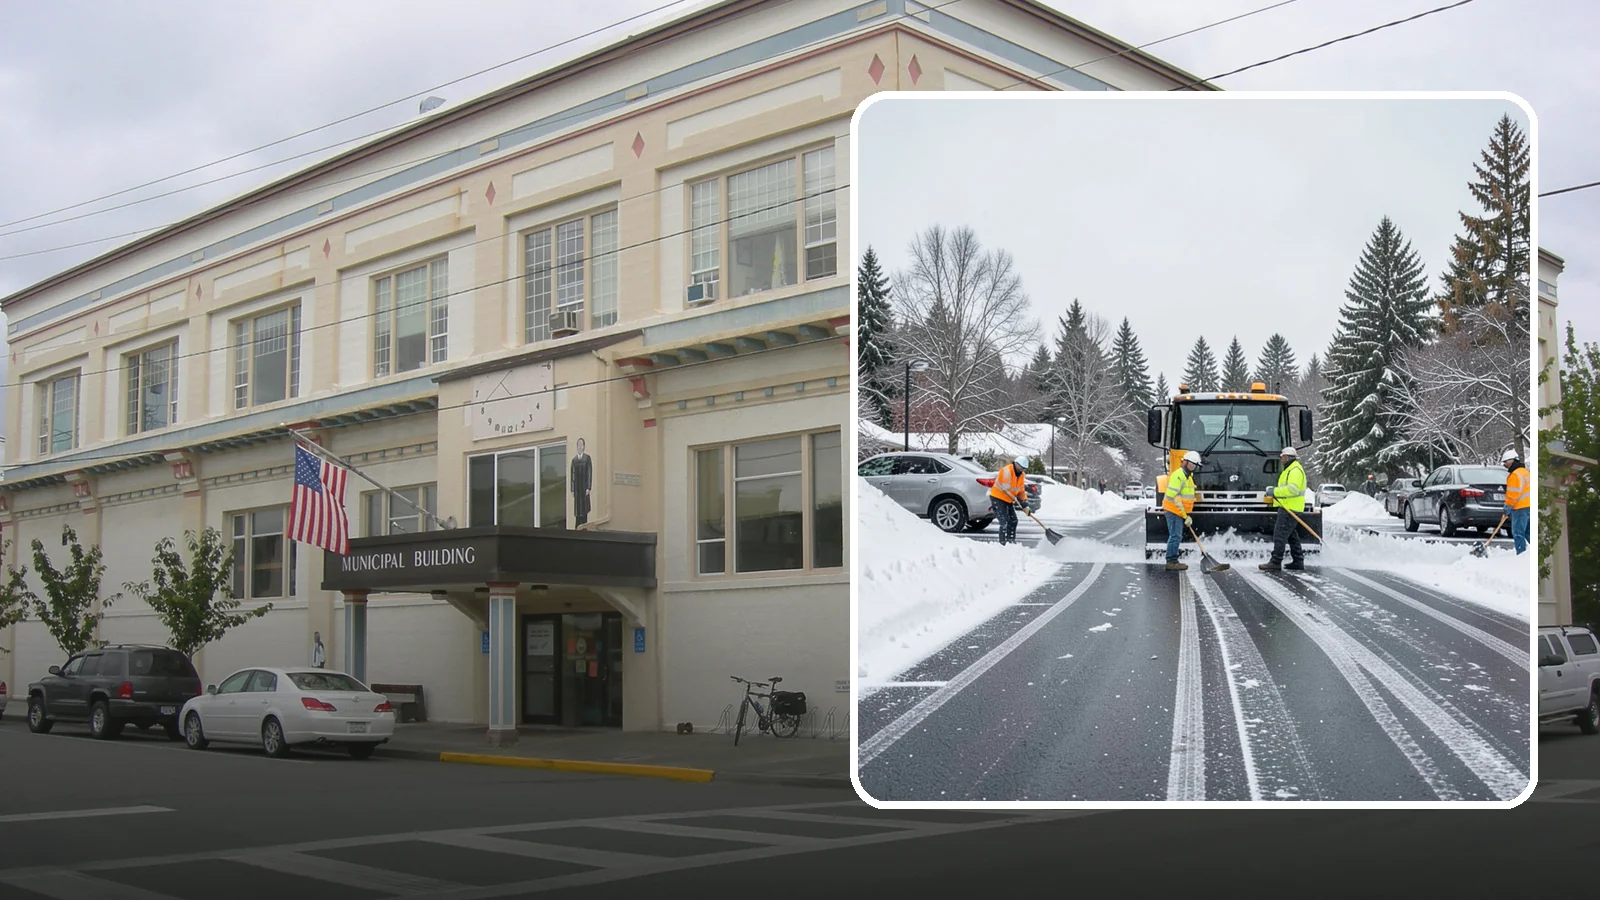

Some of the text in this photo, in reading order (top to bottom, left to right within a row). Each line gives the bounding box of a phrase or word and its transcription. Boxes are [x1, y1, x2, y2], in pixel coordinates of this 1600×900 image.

[475, 390, 480, 398] 7
[536, 402, 540, 410] 4
[481, 406, 485, 415] 8
[488, 418, 492, 426] 9
[529, 414, 533, 422] 3
[495, 424, 500, 432] 10
[507, 425, 513, 433] 12
[521, 420, 525, 428] 2
[342, 547, 475, 572] MUNICIPAL BUILDING
